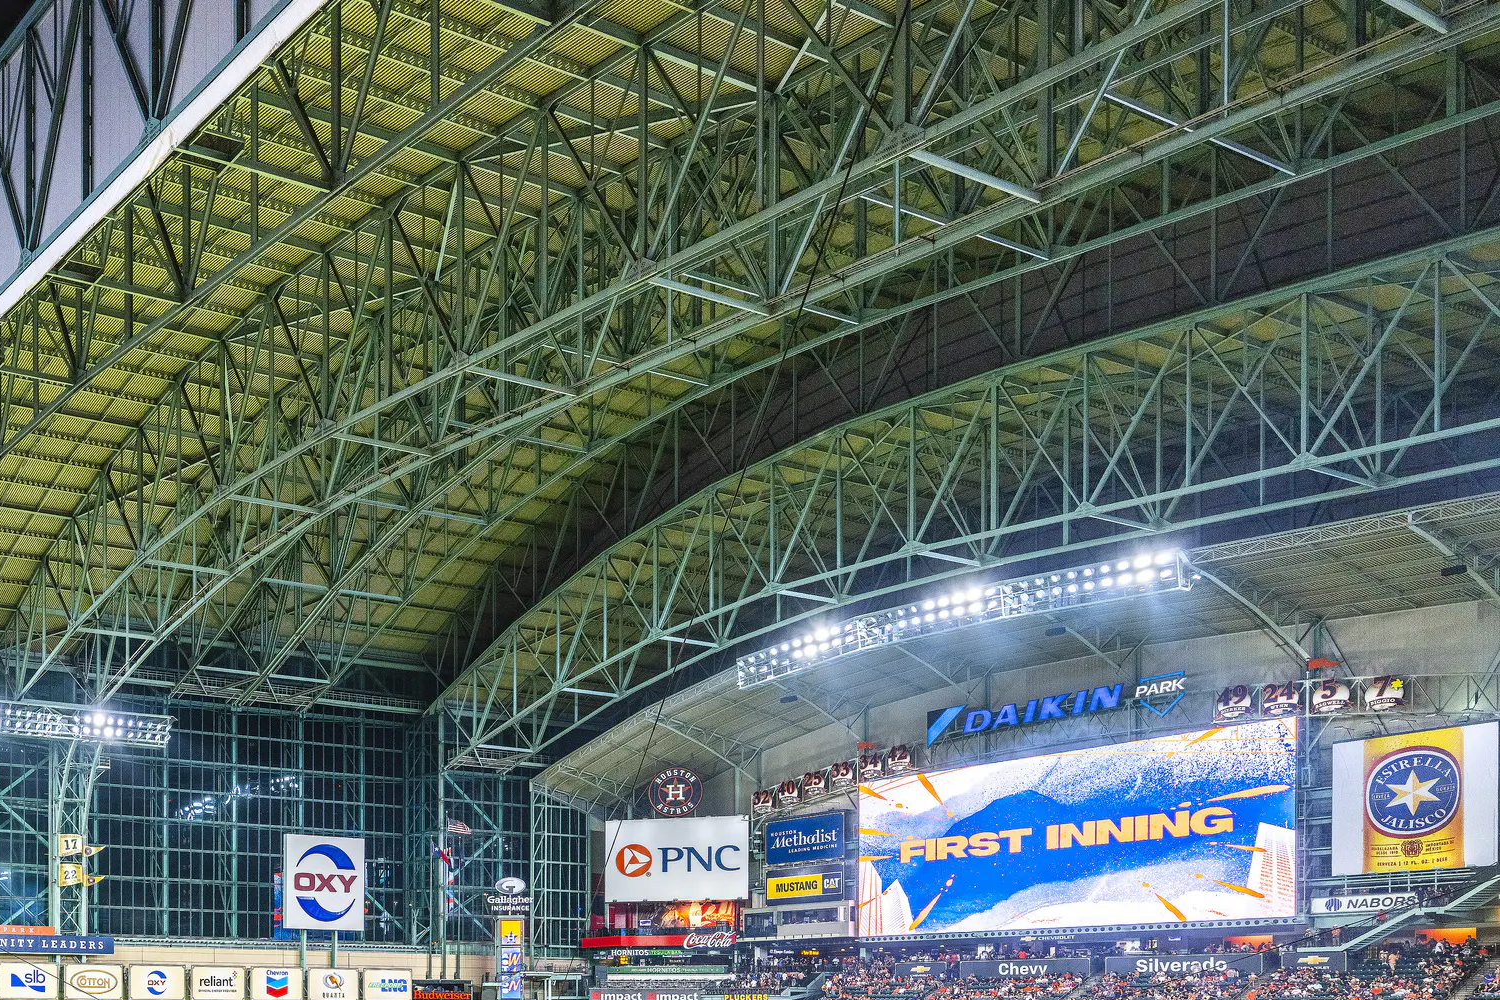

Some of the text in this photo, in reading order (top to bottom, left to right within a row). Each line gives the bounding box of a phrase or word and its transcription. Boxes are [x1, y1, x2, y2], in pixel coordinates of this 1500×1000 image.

[1263, 680, 1295, 703] 24
[1321, 678, 1338, 699] 5
[1373, 675, 1392, 697] 7
[1217, 684, 1248, 707] 49
[963, 675, 1187, 734] DAIKIN PARK
[859, 753, 879, 769] 34
[654, 769, 696, 785] HOUSTON
[831, 762, 850, 777] 33
[1375, 756, 1451, 784] ESTRELLA
[804, 772, 821, 786] 25
[666, 783, 685, 801] H
[778, 780, 797, 795] 40
[753, 791, 770, 806] 32
[654, 801, 696, 816] ASTROS
[1381, 808, 1447, 829] JALISCO
[771, 829, 838, 850] Methodist
[900, 807, 1234, 864] FIRST INNING
[64, 839, 77, 850] 17
[657, 844, 741, 873] PNC
[64, 869, 77, 879] 22
[294, 872, 357, 893] OXY
[776, 878, 840, 893] MUSTANG CAT
[487, 895, 533, 906] Gallagher
[42, 939, 104, 949] LEADERS
[683, 930, 736, 950] Coca-Cola
[266, 969, 289, 977] Chevron
[998, 957, 1227, 977] Chevy Silverado
[24, 970, 45, 984] slb
[76, 975, 112, 989] COTTON
[199, 977, 233, 987] reliant
[381, 978, 407, 993] LNG
[413, 990, 471, 1000] Budweiser
